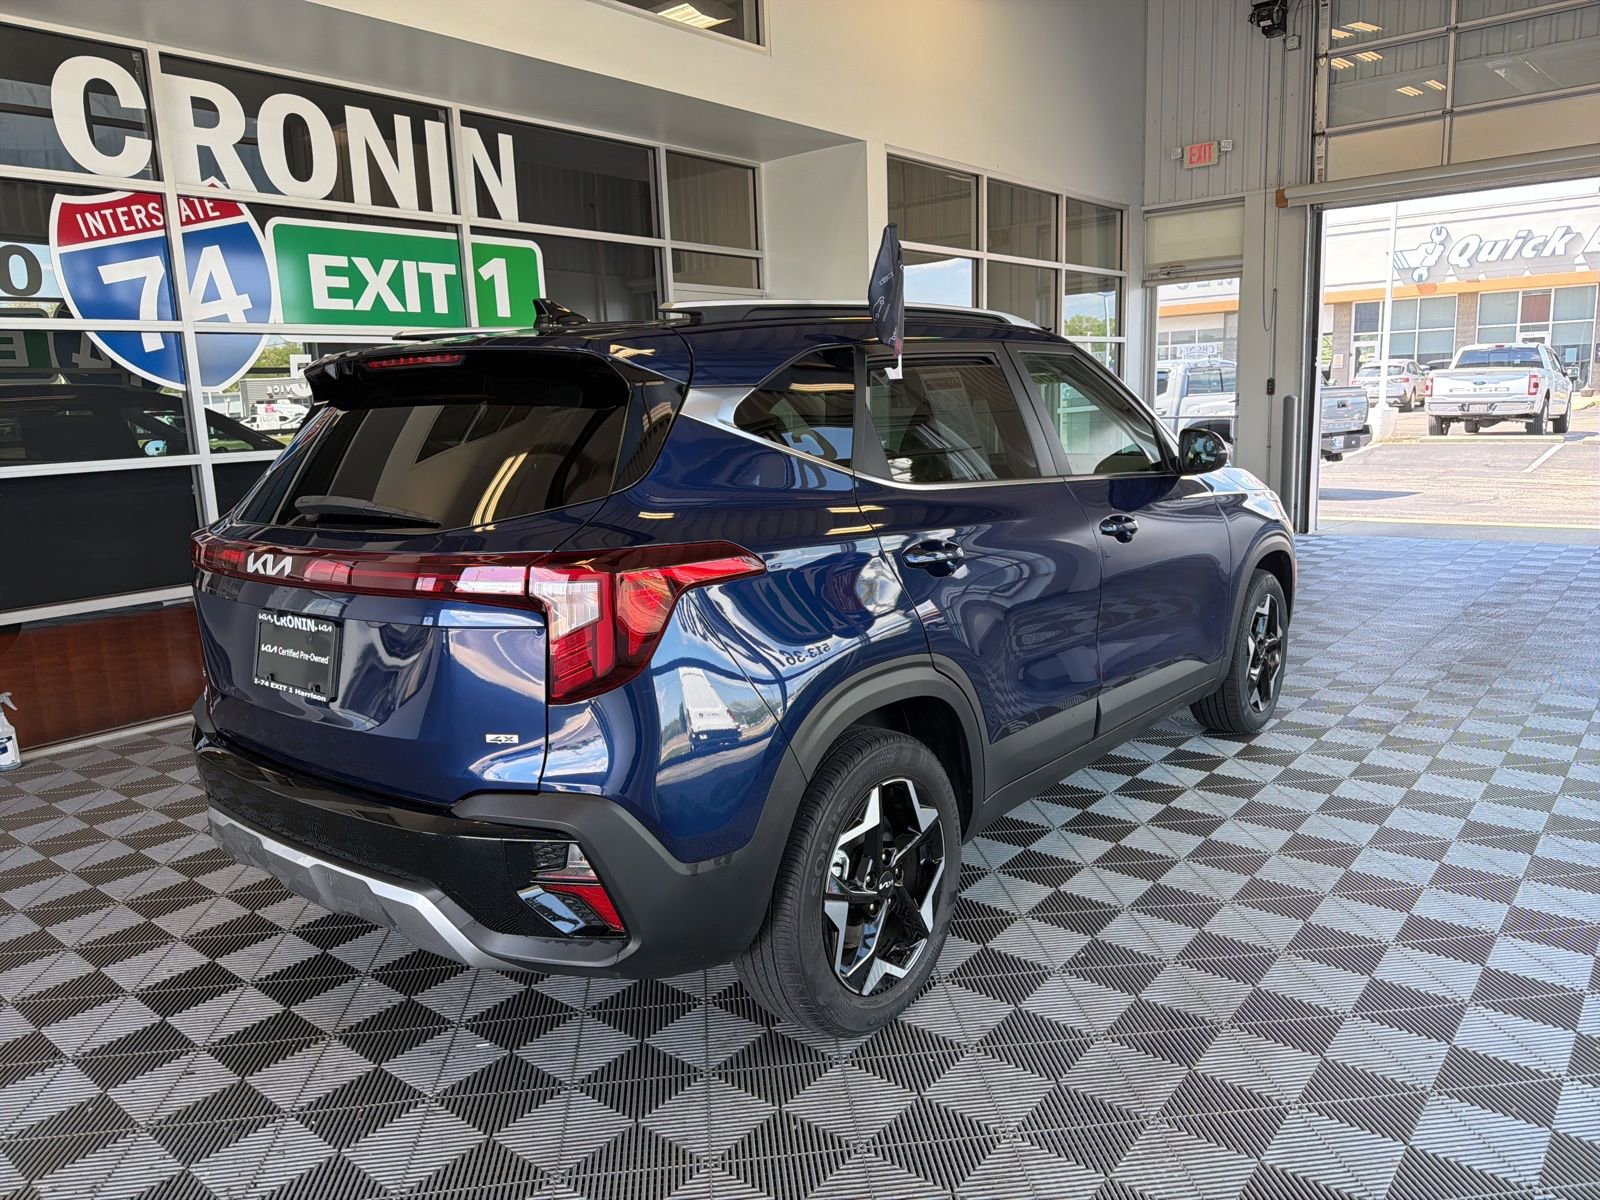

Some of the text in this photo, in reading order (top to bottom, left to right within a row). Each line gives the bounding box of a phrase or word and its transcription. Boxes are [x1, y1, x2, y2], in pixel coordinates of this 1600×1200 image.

[50, 55, 519, 223] CRONIN
[1189, 143, 1214, 165] EXIT
[75, 198, 221, 239] INTERSATE
[1447, 225, 1578, 268] Quick
[98, 245, 251, 353] 74
[307, 253, 512, 318] EXIT 1
[246, 551, 293, 577] KIA
[278, 646, 300, 660] Certified
[299, 650, 330, 665] Pre-Owned
[270, 681, 288, 692] EXIT
[288, 686, 294, 694] 1
[294, 688, 327, 702] Harrison
